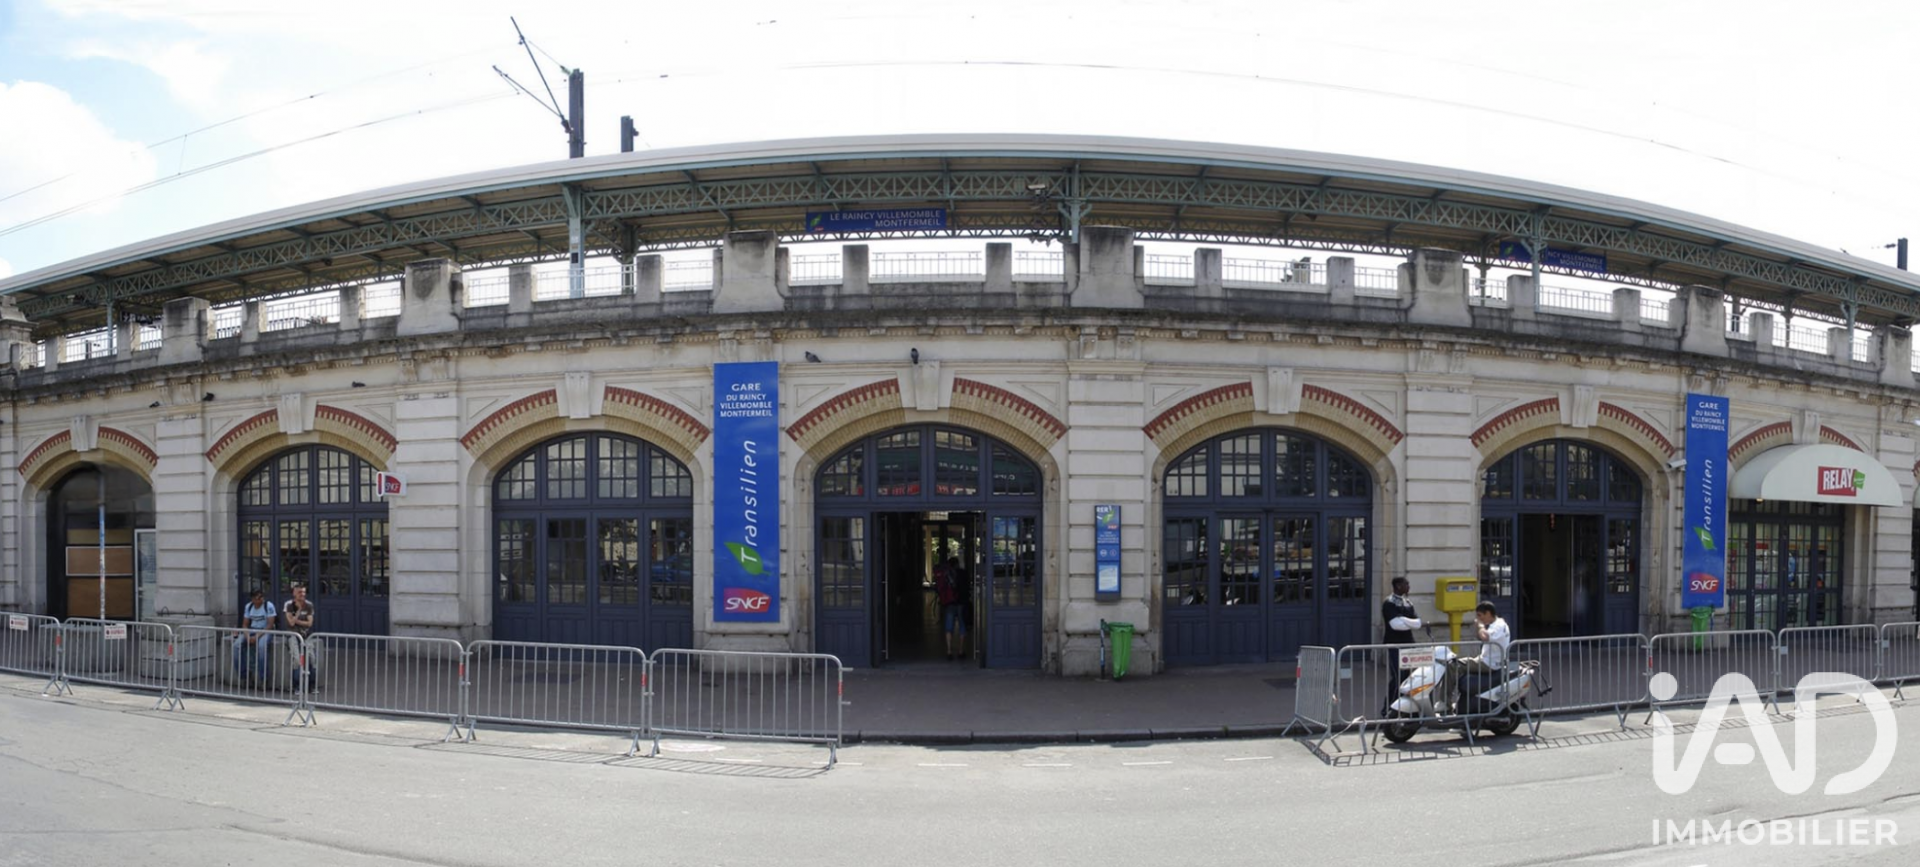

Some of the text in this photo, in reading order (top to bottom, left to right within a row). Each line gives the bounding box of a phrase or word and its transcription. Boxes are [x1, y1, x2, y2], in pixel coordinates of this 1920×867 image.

[830, 209, 941, 221] LE RAINCY VILLEMOMBLE
[875, 218, 941, 227] MONTFERMEIL
[731, 383, 761, 391] GARE
[720, 401, 773, 409] VILLEMOMBLE
[1699, 402, 1719, 410] GARE
[1823, 469, 1854, 491] RELAY
[740, 440, 757, 562] Transilien
[1702, 459, 1712, 541] Transilien
[1691, 580, 1718, 591] SNCF
[725, 597, 769, 610] SNCF
